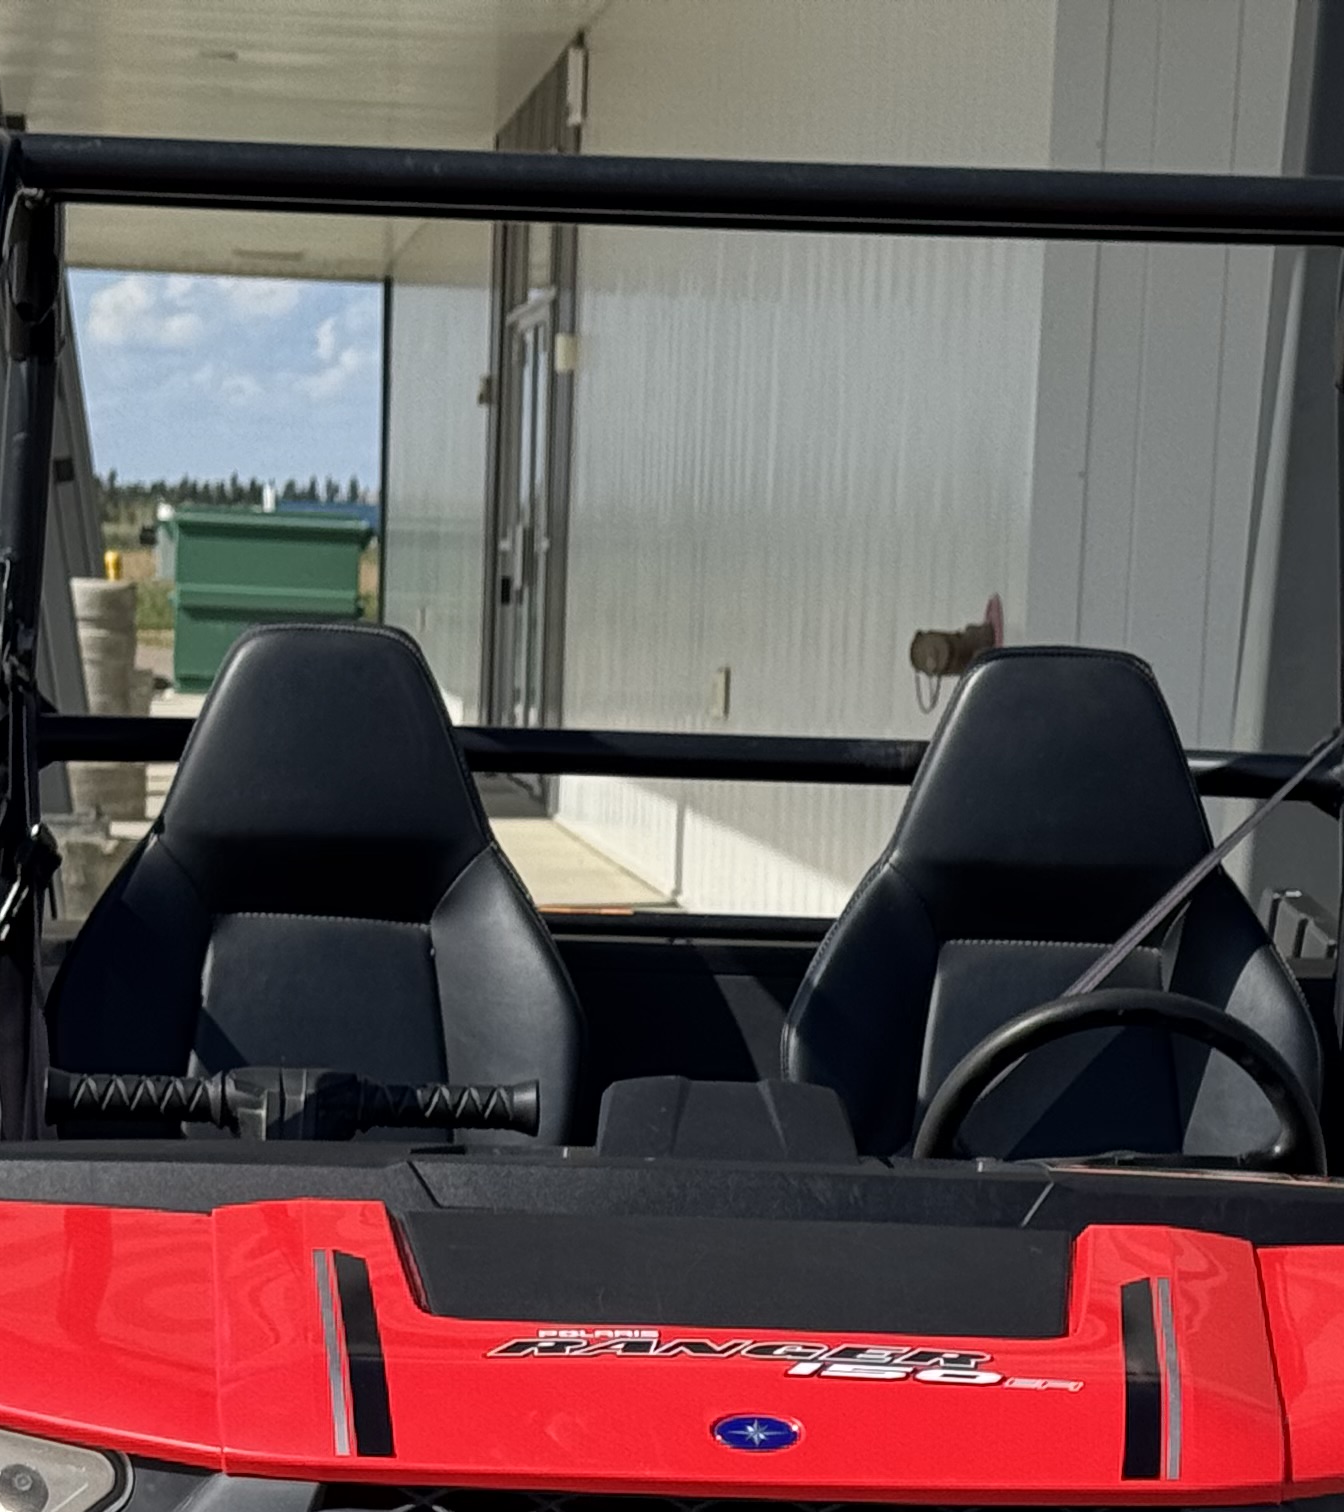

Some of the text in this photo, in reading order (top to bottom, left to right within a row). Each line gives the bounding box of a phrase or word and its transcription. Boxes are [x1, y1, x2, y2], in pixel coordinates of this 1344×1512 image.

[537, 1329, 660, 1339] POLARIS
[486, 1338, 993, 1368] RANGER
[784, 1361, 1003, 1385] 150
